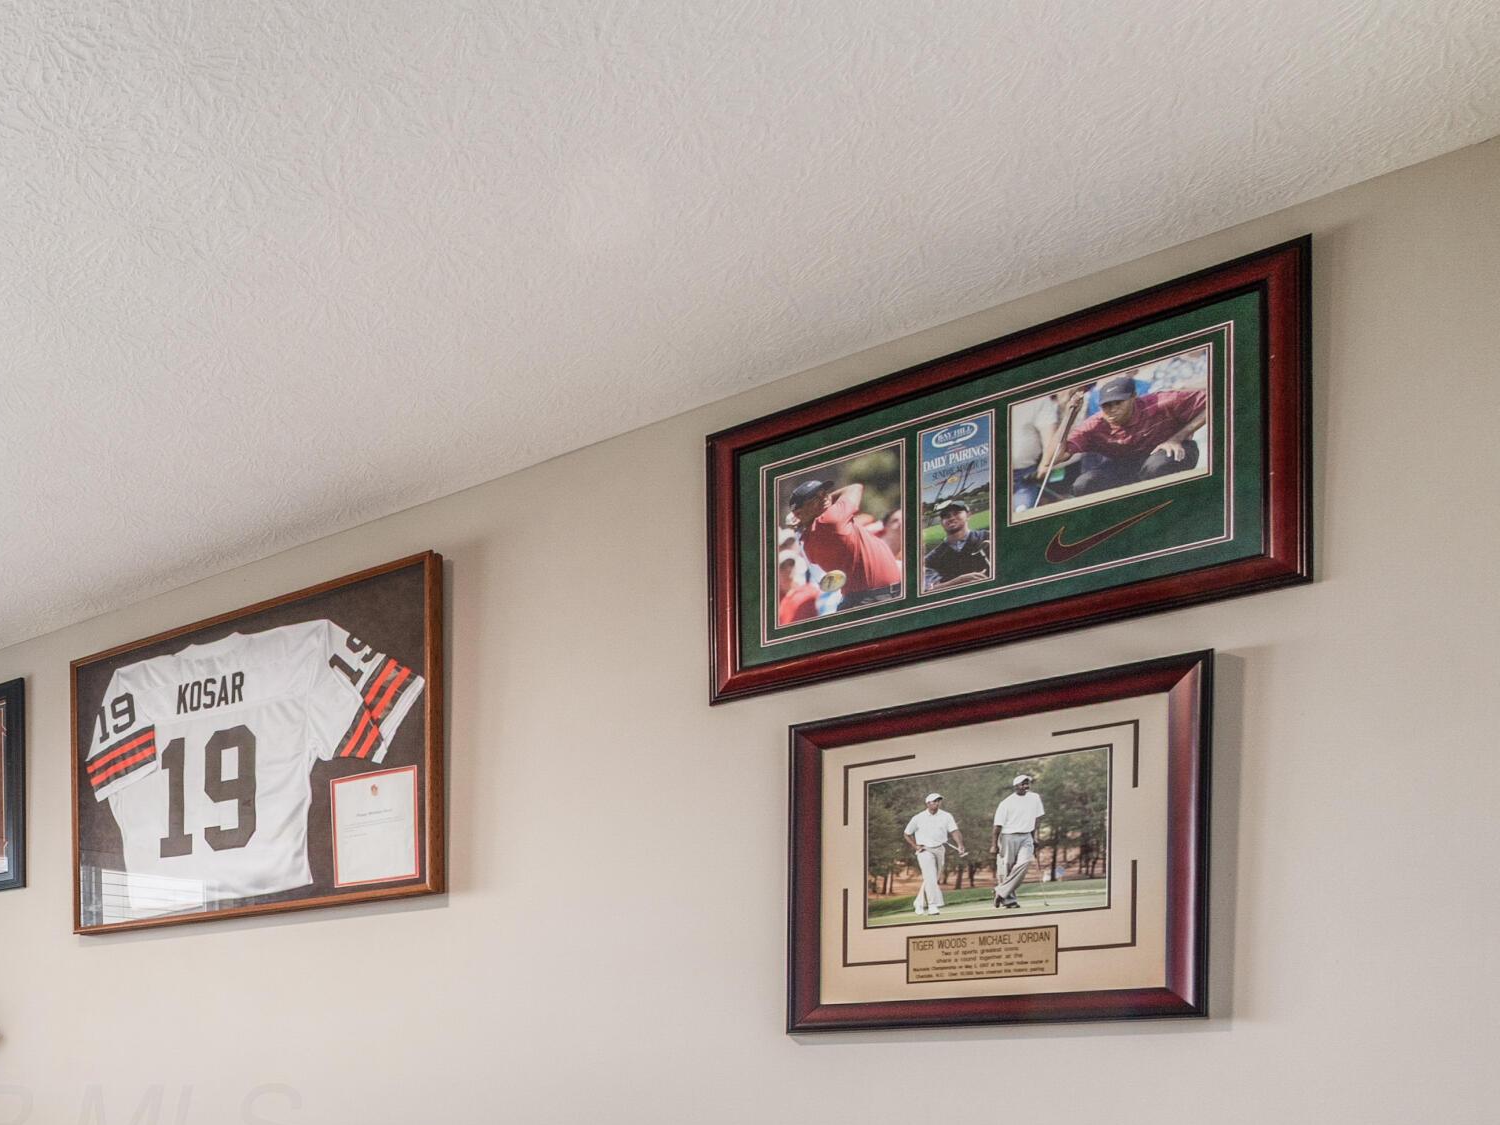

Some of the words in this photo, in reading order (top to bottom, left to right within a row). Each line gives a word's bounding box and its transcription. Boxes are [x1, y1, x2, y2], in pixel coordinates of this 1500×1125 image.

[923, 455, 947, 472] DAILY
[948, 443, 989, 464] PAIRINGS
[176, 671, 245, 715] KOSAR
[100, 692, 136, 744] 19
[160, 724, 257, 858] 19
[912, 940, 934, 951] TIGER
[938, 937, 967, 949] WOODS
[979, 934, 1013, 946] MICHAEL
[1017, 930, 1050, 944] JORDAN
